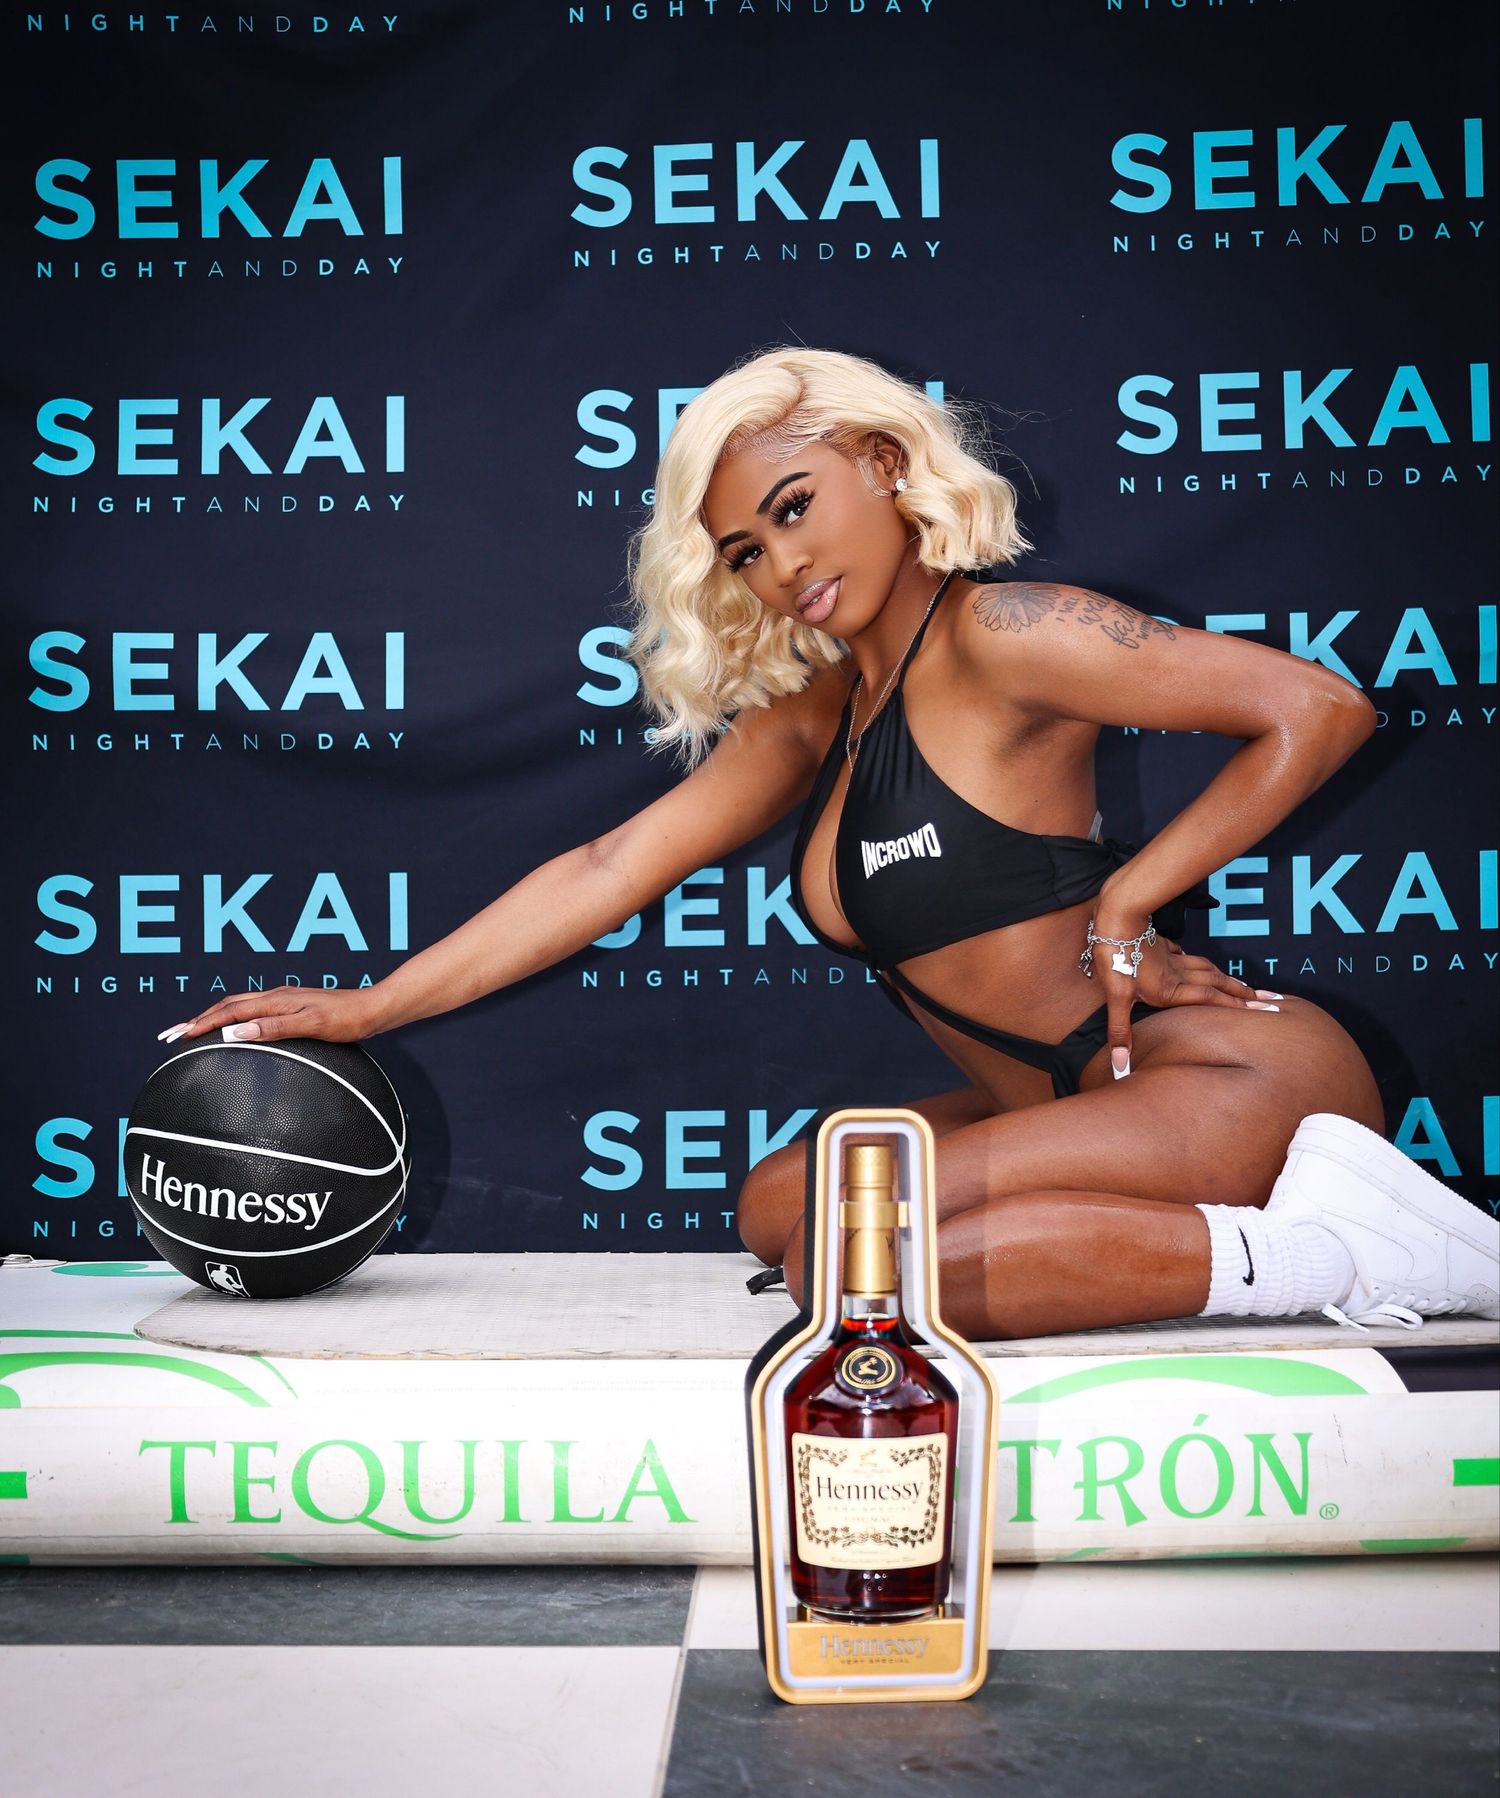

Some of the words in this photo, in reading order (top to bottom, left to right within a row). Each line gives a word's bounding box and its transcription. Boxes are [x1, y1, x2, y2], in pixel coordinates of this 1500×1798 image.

[34, 156, 404, 240] SEKAI
[570, 139, 941, 228] SEKAI
[1110, 117, 1485, 213] SEKAI
[32, 395, 405, 476] SEKAI
[1116, 363, 1491, 455] SEKAI
[28, 631, 405, 712] SEKAI
[1205, 605, 1498, 689] KAI
[861, 822, 942, 879] INCROWD
[34, 872, 409, 955] SEKAI
[1207, 850, 1499, 938] EKAI
[141, 1153, 333, 1231] Hennessy
[579, 1108, 819, 1192] SEK
[138, 1438, 698, 1541] TEQUILA
[816, 1475, 923, 1504] Hennessy
[819, 1632, 929, 1659] Hennessy
